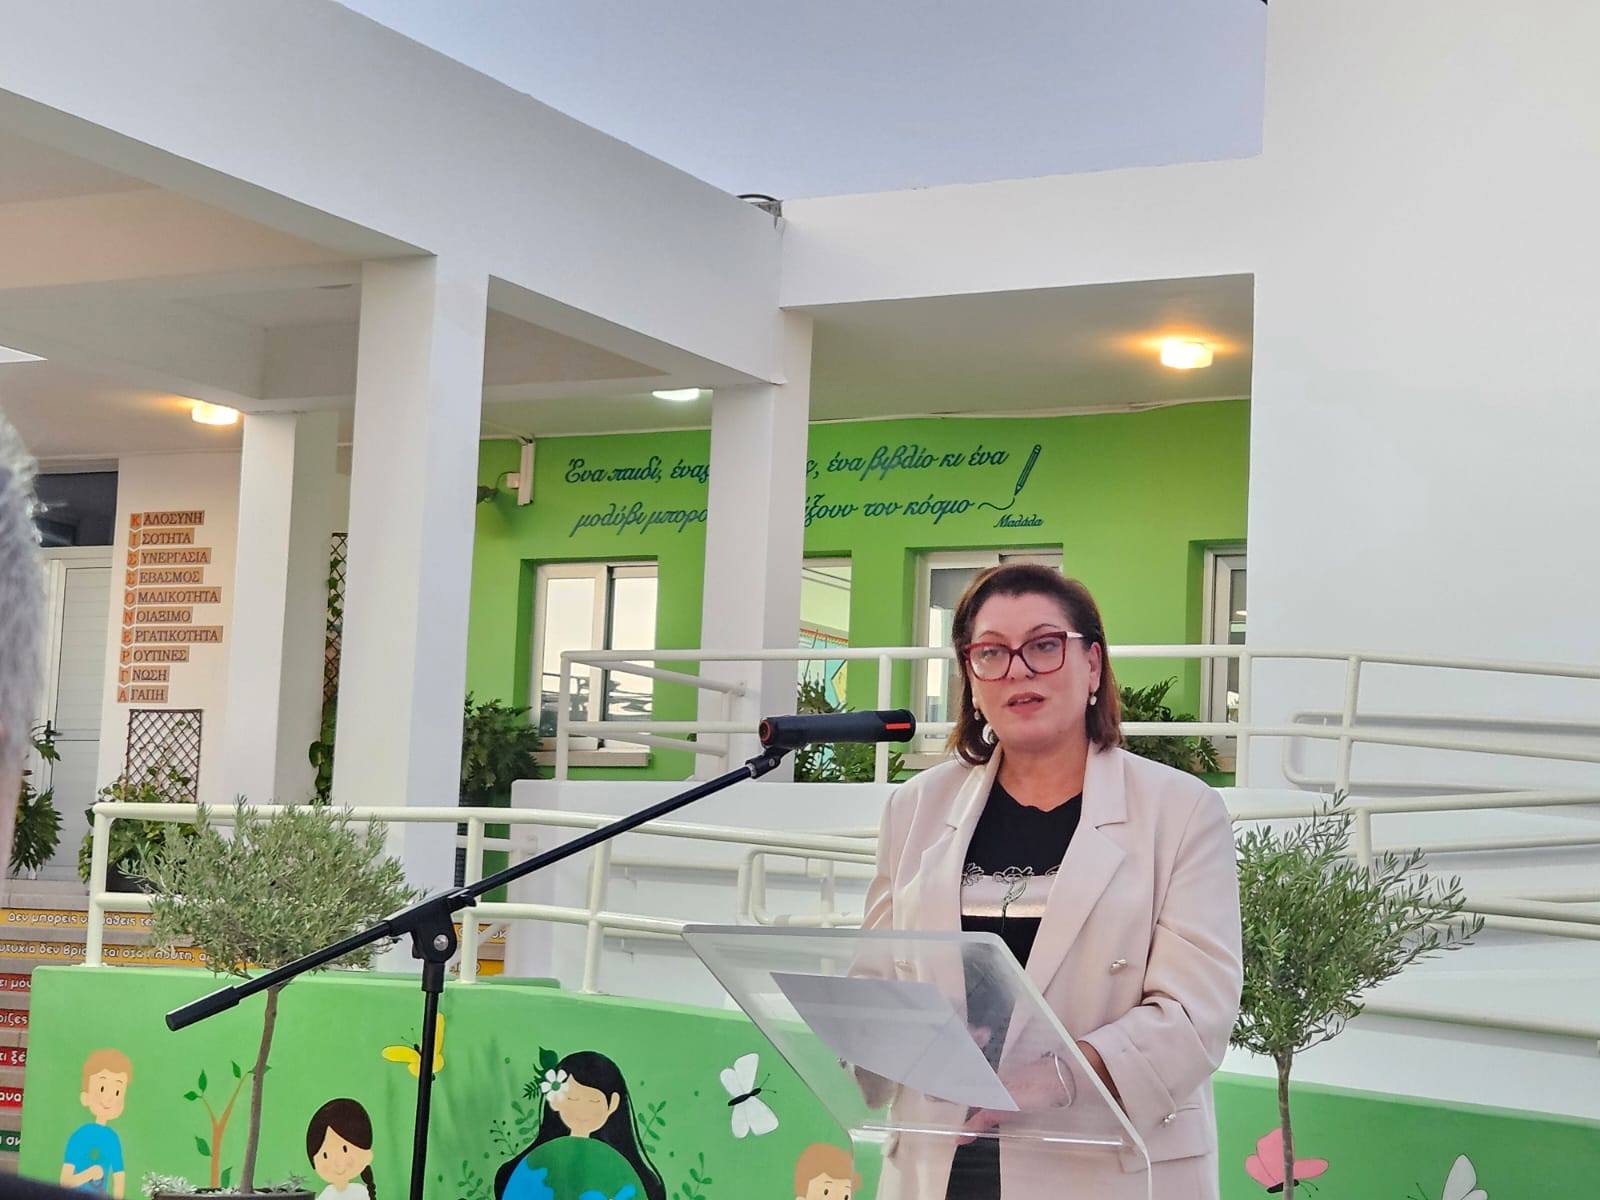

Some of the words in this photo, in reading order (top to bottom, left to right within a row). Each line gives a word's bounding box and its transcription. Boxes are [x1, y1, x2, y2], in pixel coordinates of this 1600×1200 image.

[565, 458, 607, 483] Ένα
[607, 456, 662, 483] παιδί,
[827, 451, 865, 472] ένα
[859, 445, 938, 481] βιβλίο
[938, 451, 965, 468] κι
[968, 445, 1010, 467] ένα
[569, 502, 645, 537] μολύβι
[640, 507, 708, 534] μπορο
[863, 502, 902, 517] τον
[903, 494, 975, 524] κόσμο
